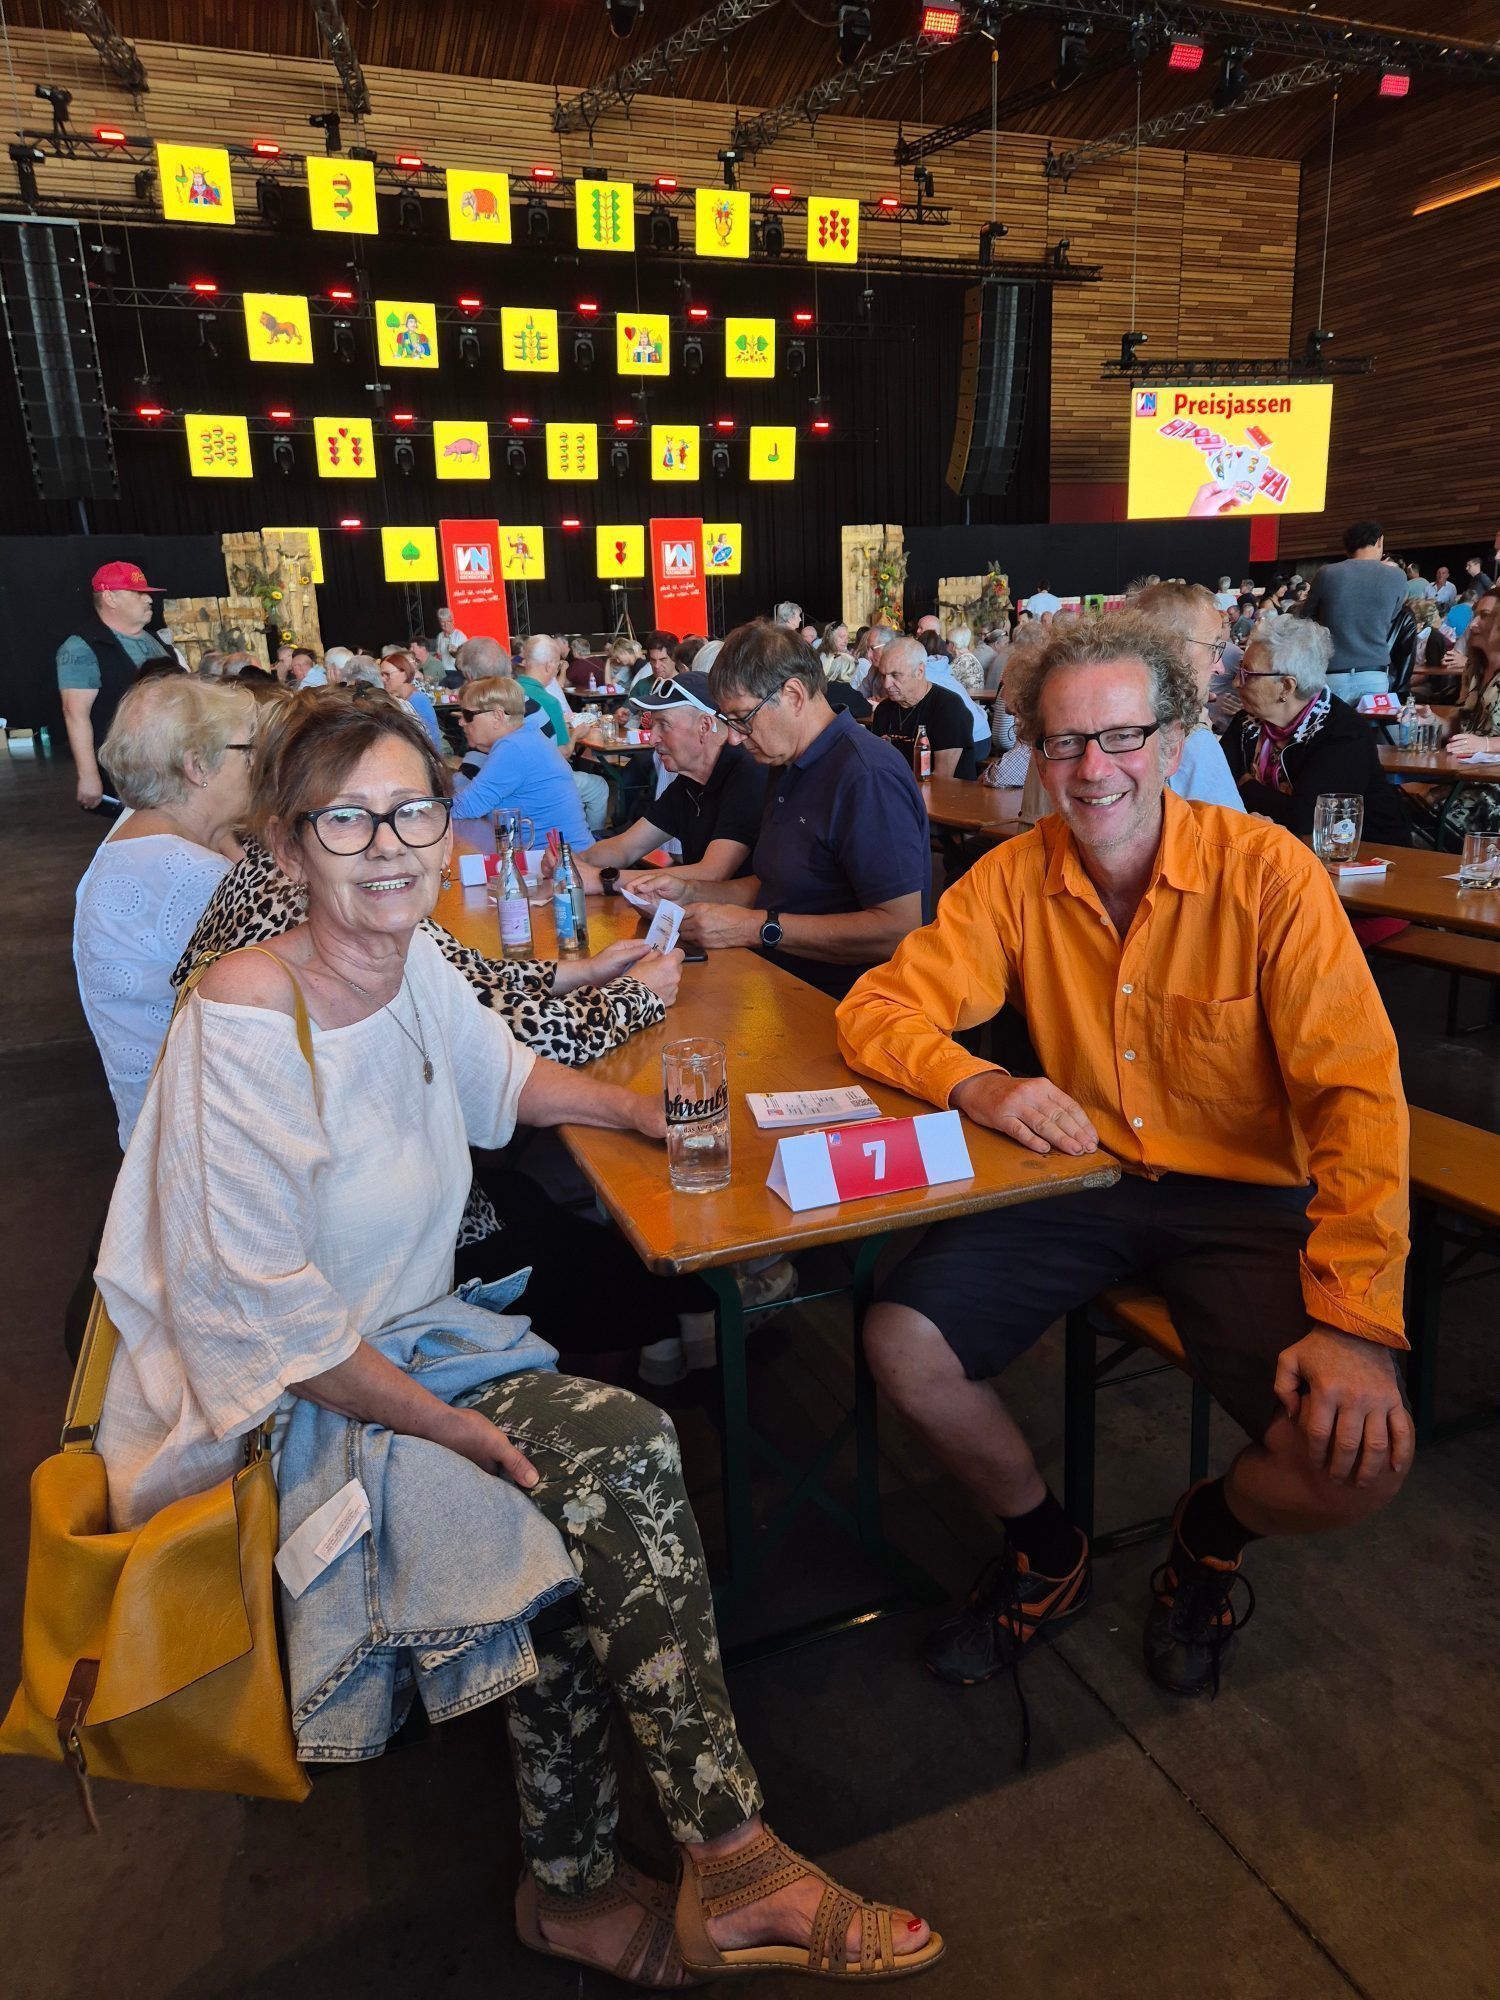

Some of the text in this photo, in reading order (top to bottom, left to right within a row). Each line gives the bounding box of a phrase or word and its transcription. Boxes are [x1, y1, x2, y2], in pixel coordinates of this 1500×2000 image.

[1136, 392, 1291, 419] VN Preisjassen
[456, 546, 490, 571] VN
[664, 543, 693, 567] VN
[862, 1139, 886, 1180] 7
